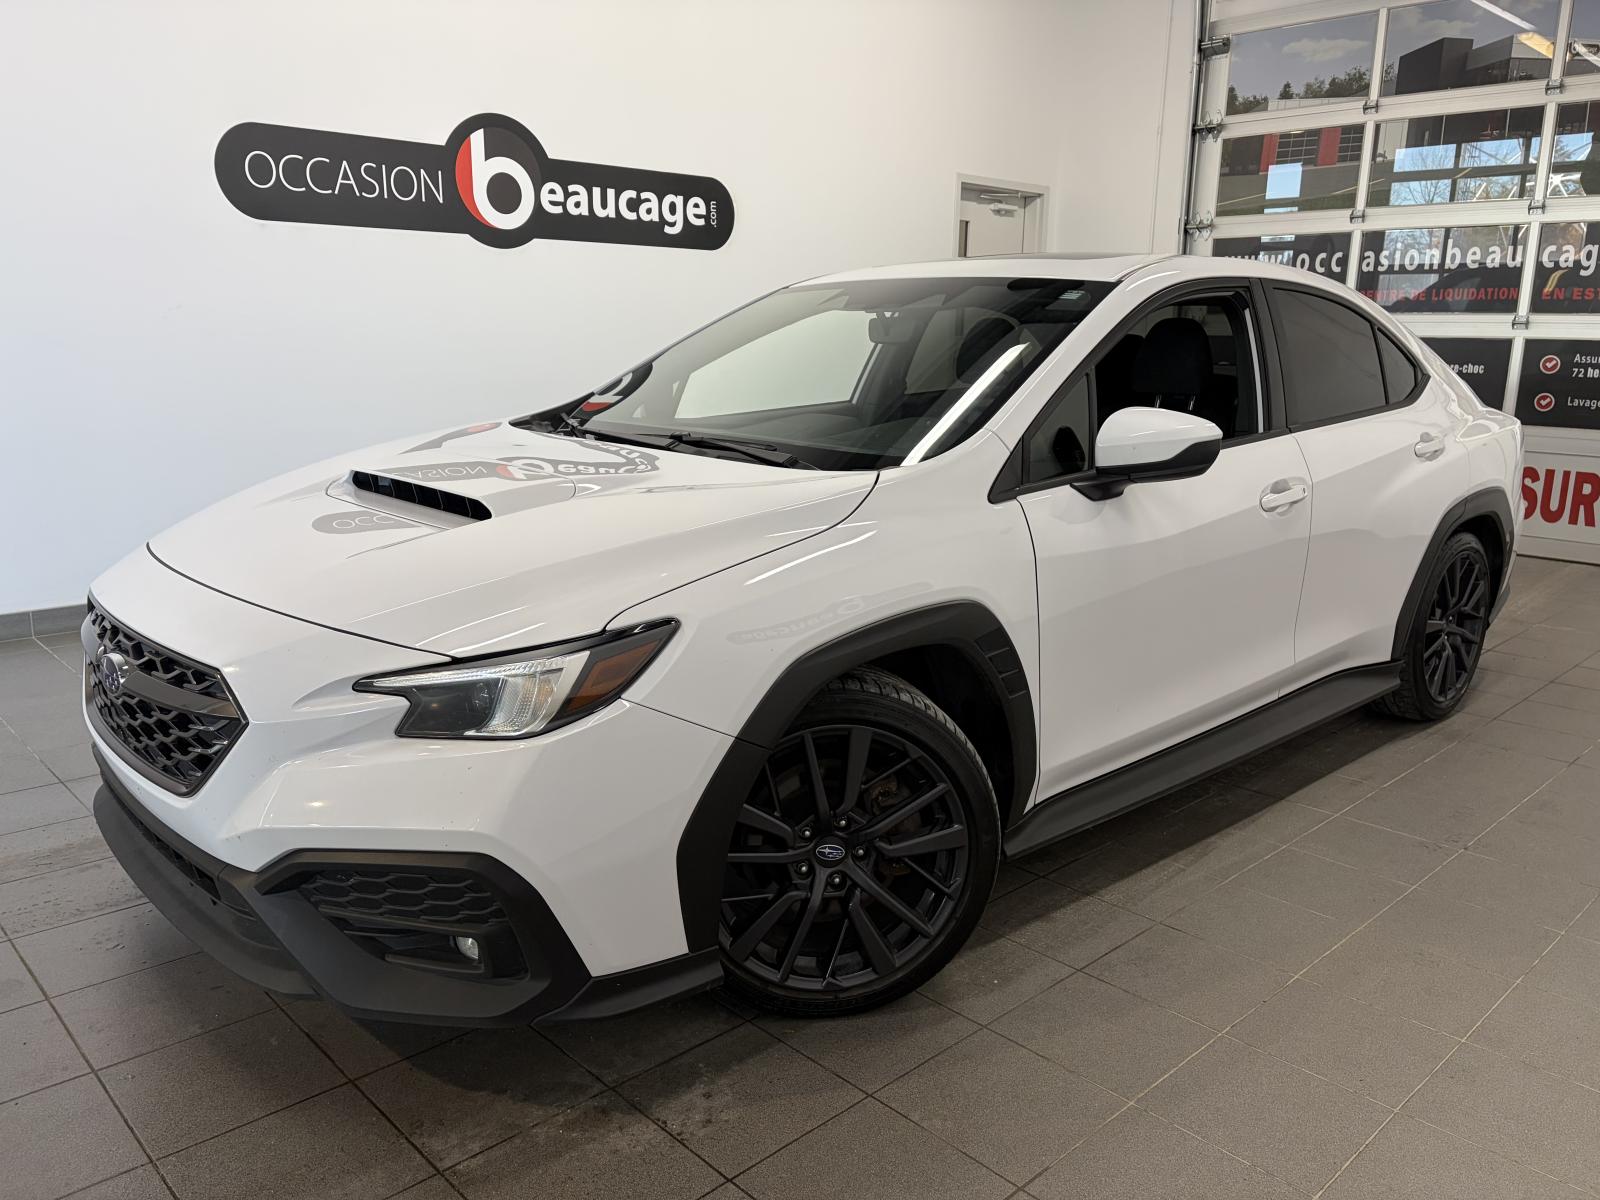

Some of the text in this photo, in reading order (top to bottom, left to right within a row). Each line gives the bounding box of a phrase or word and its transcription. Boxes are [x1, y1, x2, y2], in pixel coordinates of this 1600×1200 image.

[244, 150, 444, 204] OCCASION
[709, 200, 718, 229] .com
[1411, 288, 1427, 302] DE
[1431, 287, 1520, 301] LIQUIDATION
[1541, 287, 1565, 300] EN
[1449, 363, 1485, 375] re-choc
[1572, 367, 1585, 378] 72
